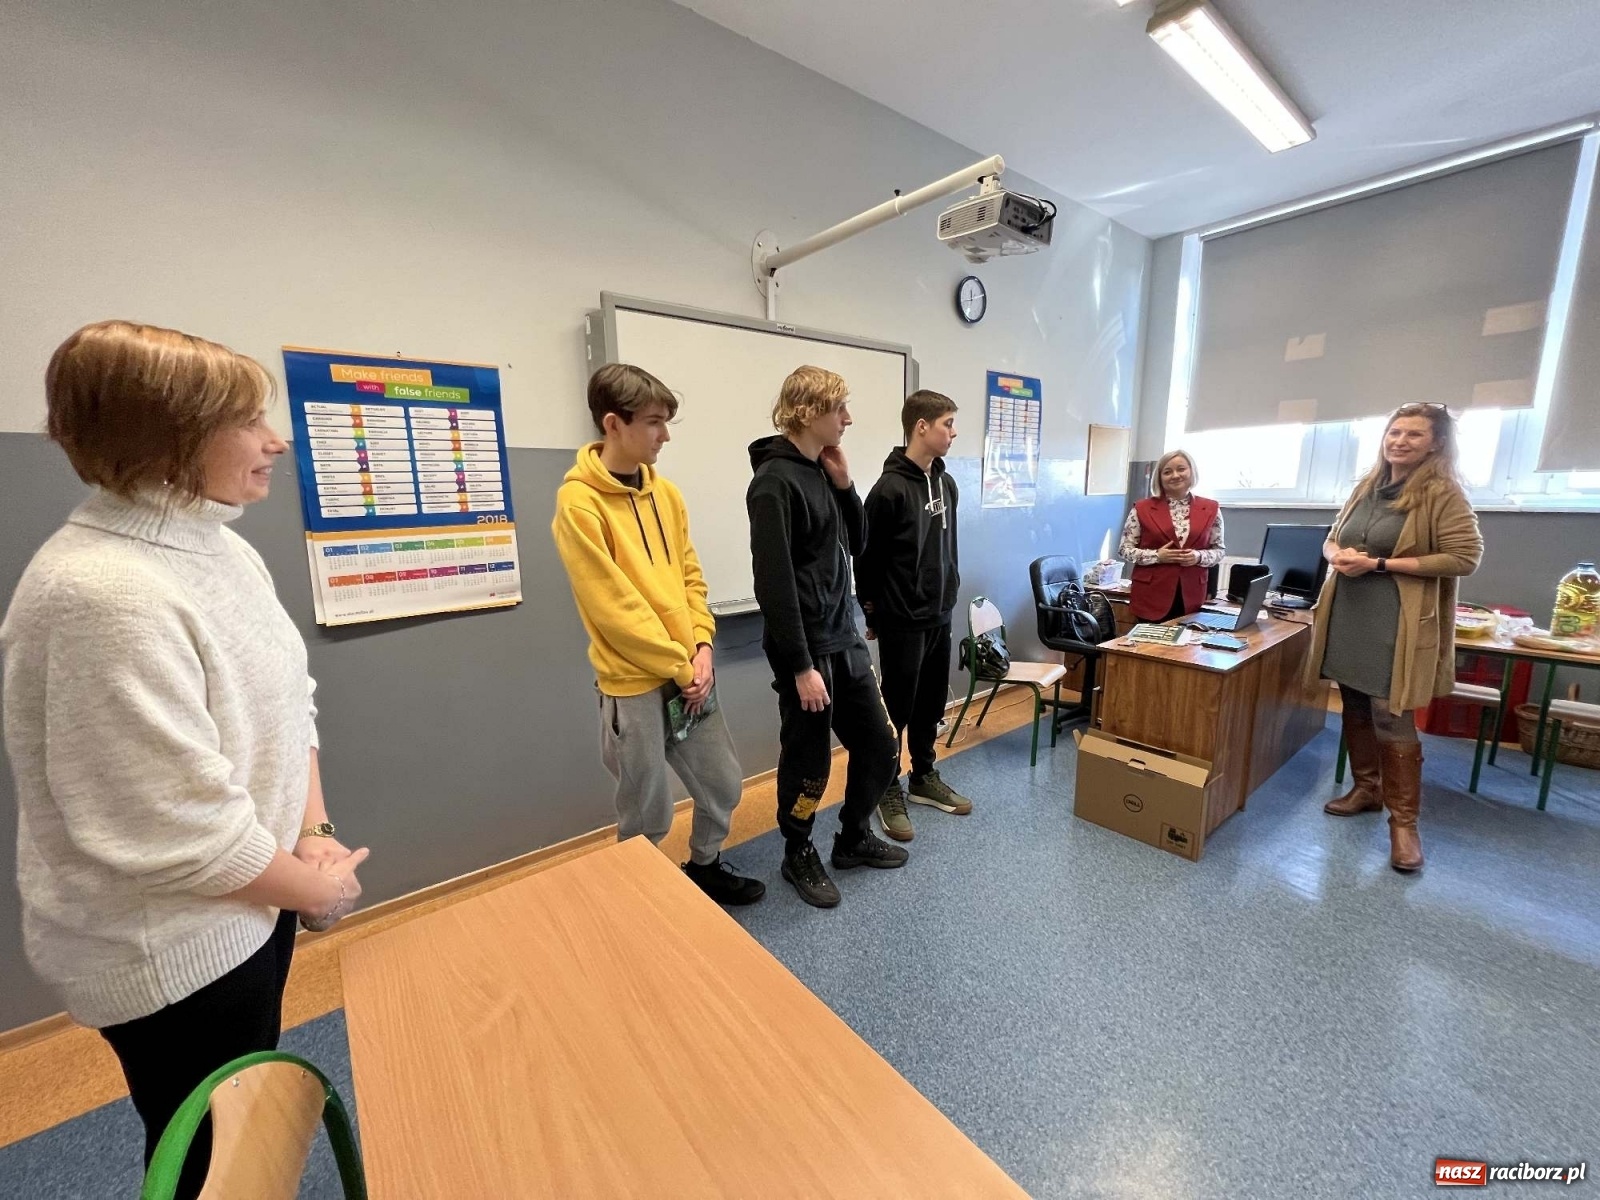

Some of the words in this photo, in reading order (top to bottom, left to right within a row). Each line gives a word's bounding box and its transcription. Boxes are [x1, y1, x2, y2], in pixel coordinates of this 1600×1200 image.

[341, 367, 376, 381] Make
[380, 369, 424, 383] friends
[363, 383, 379, 391] with
[394, 386, 422, 397] false
[424, 388, 461, 399] friends
[477, 515, 508, 524] 2018
